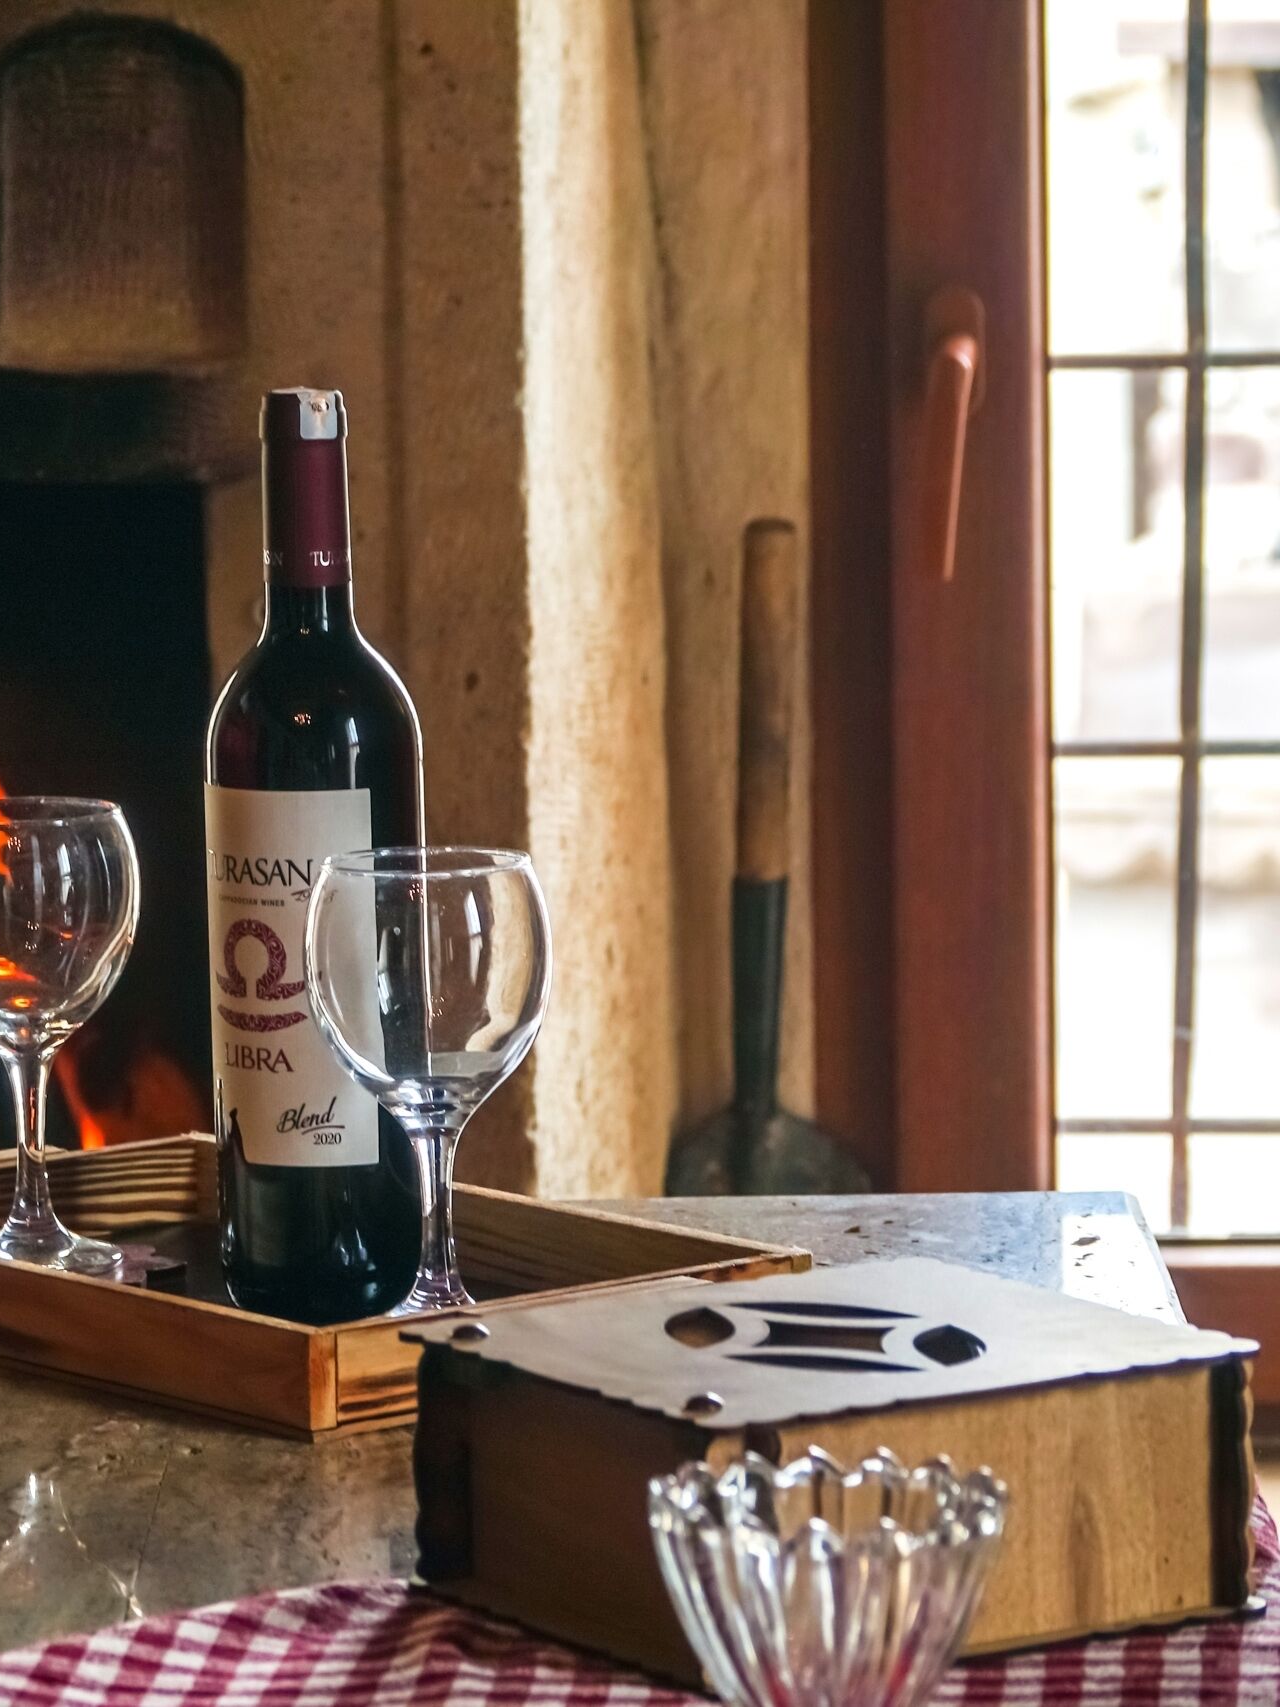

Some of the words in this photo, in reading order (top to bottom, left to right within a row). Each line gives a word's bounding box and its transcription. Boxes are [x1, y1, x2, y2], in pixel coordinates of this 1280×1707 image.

[212, 852, 313, 886] URASAN
[225, 1042, 294, 1073] LIBRA
[276, 1096, 337, 1133] Blend
[313, 1132, 342, 1145] 2020
